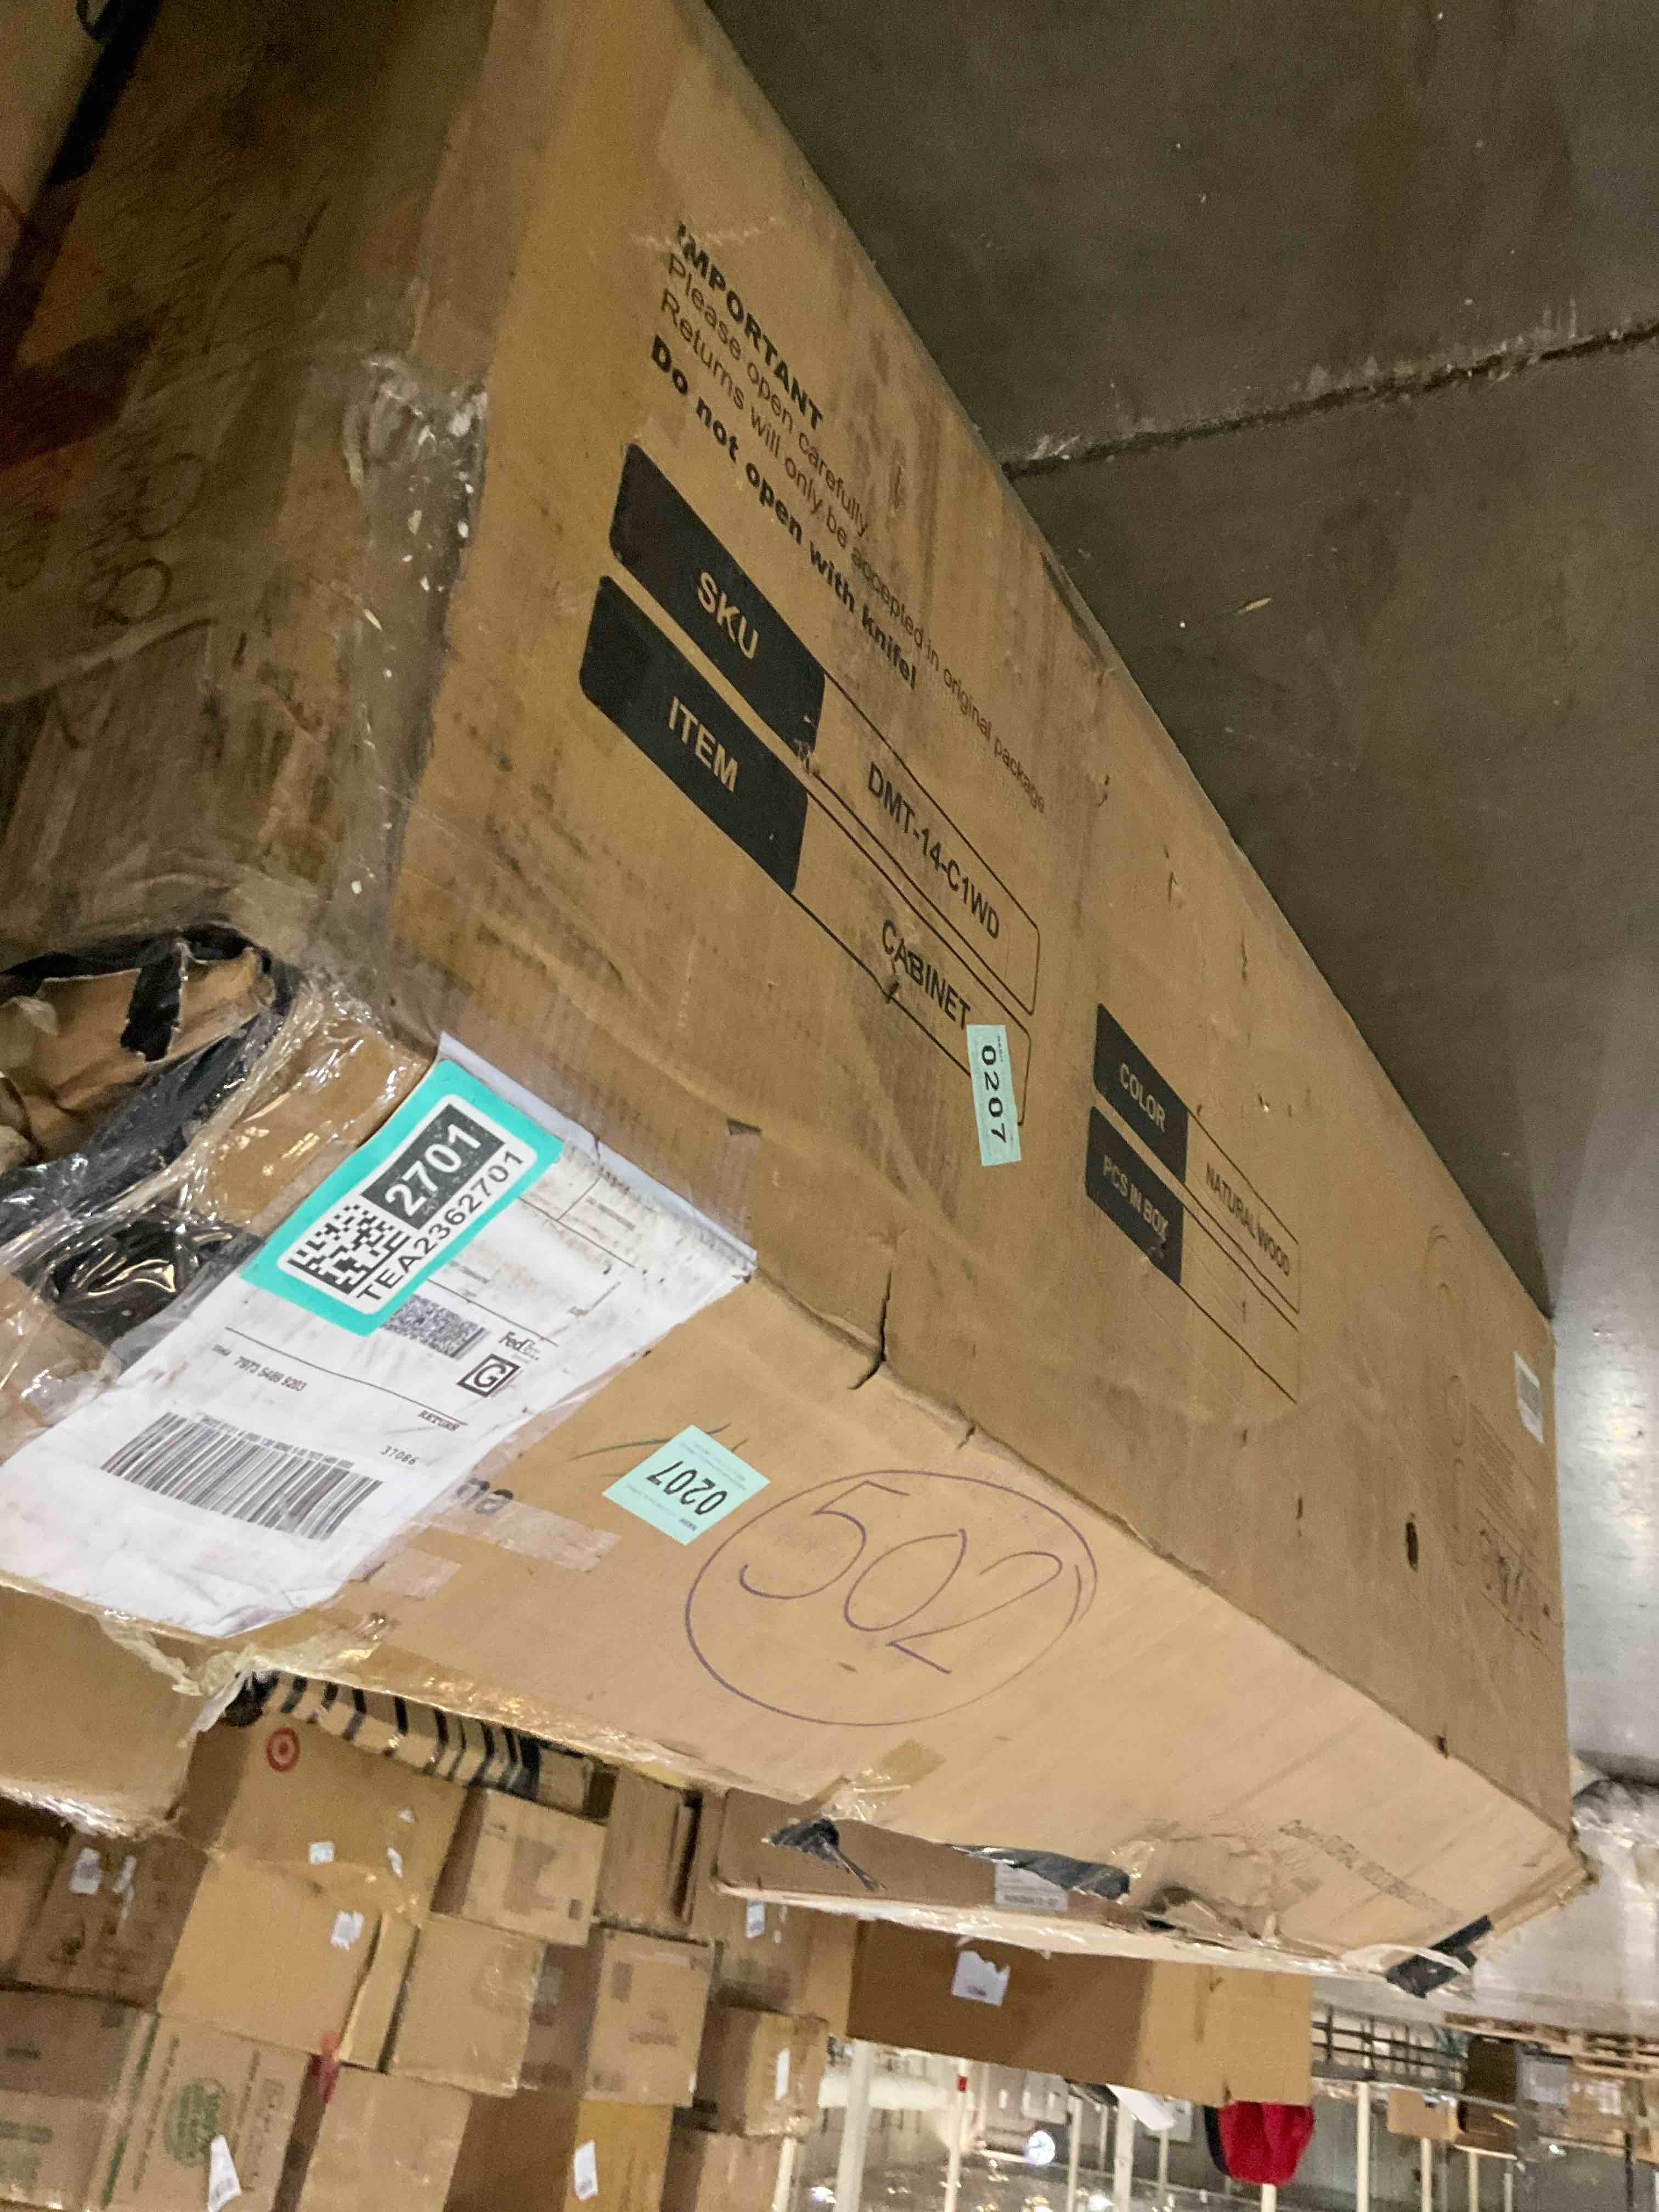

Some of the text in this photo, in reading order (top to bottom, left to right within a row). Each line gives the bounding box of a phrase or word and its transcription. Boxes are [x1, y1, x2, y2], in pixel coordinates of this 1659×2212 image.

[676, 221, 823, 431] IMPORTANT
[668, 252, 868, 538] Please open carefully
[651, 334, 918, 690] Do not open with knife!
[661, 287, 1045, 813] Returns will only be accepted in original package
[698, 570, 759, 660] SKU
[668, 696, 738, 793] ITEM
[867, 761, 1001, 940] DMT-14-C1WD
[881, 918, 971, 1031] CABINET
[981, 1043, 1007, 1144] 0207
[1119, 1063, 1166, 1134] COLOR
[385, 1122, 483, 1217] 2701
[1103, 1154, 1169, 1244] PCS IN BOX
[1206, 1163, 1290, 1277] NATURAL WOOD
[358, 1150, 525, 1300] TEA2362701
[473, 1363, 507, 1388] G
[646, 1459, 729, 1516] 0207
